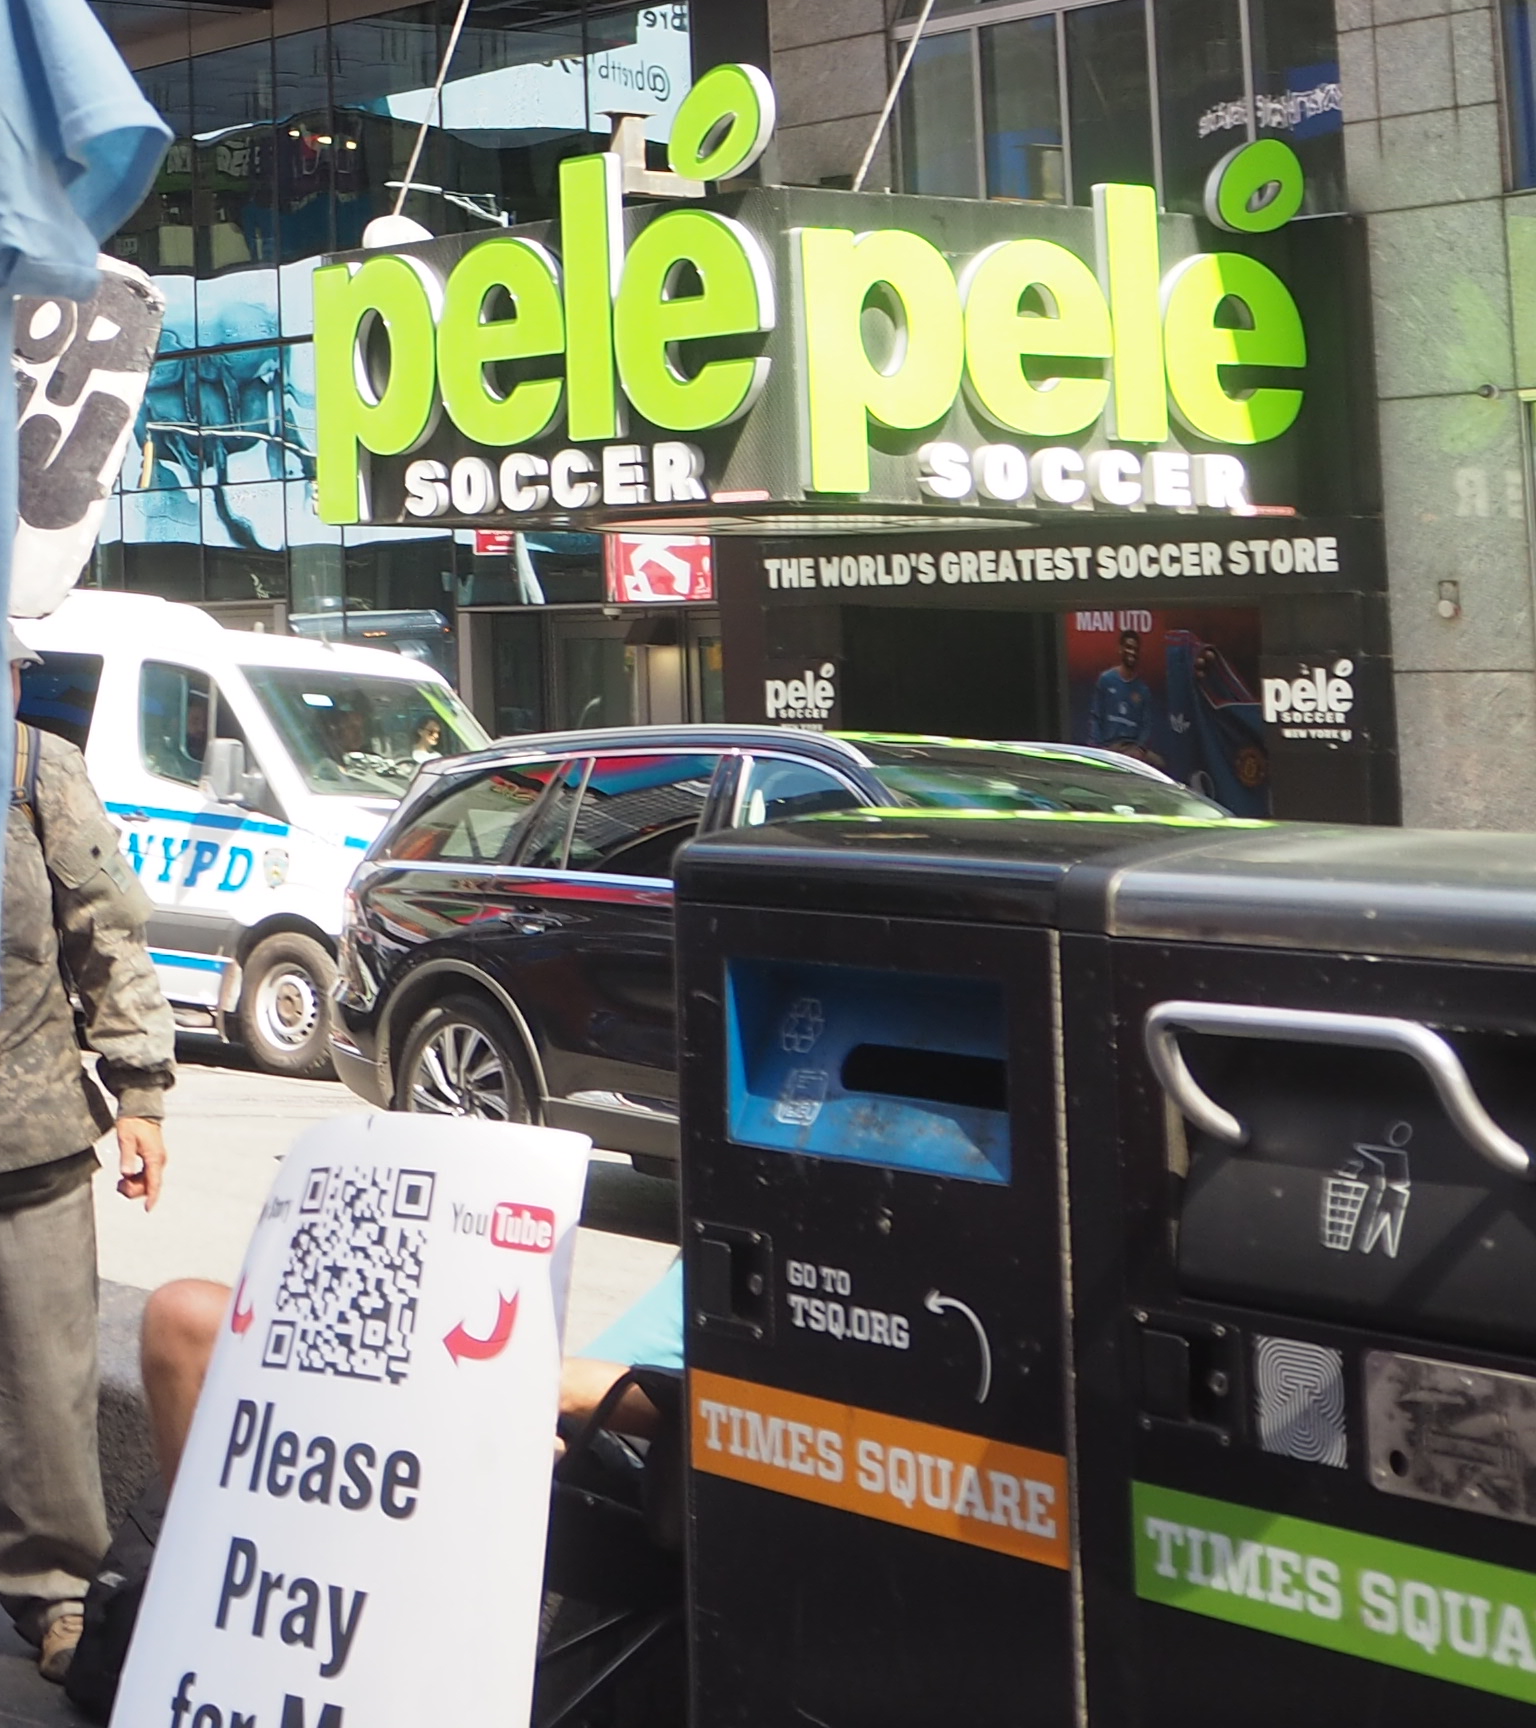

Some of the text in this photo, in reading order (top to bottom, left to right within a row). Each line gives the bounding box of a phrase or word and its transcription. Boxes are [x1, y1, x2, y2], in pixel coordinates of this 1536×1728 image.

[312, 62, 776, 526] pelé
[790, 138, 1308, 494] pelé
[405, 440, 707, 518] SOCCER
[917, 441, 1251, 511] SOCCER
[765, 537, 1339, 590] THE WORLD'S GREATEST SOCCER STORE
[1076, 610, 1153, 633] MAN UTD
[765, 662, 836, 719] pelé
[778, 707, 829, 719] SOCCER
[1261, 659, 1353, 723] pelé
[1280, 711, 1346, 724] SOCCER
[127, 830, 253, 893] NYPD
[786, 1260, 851, 1298] GO TO
[788, 1293, 911, 1351] TSQ.ORG
[219, 1398, 422, 1521] Please
[699, 1398, 1057, 1540] TIMES SQUARE
[1145, 1516, 1342, 1621] TIMES
[214, 1535, 369, 1678] Pray
